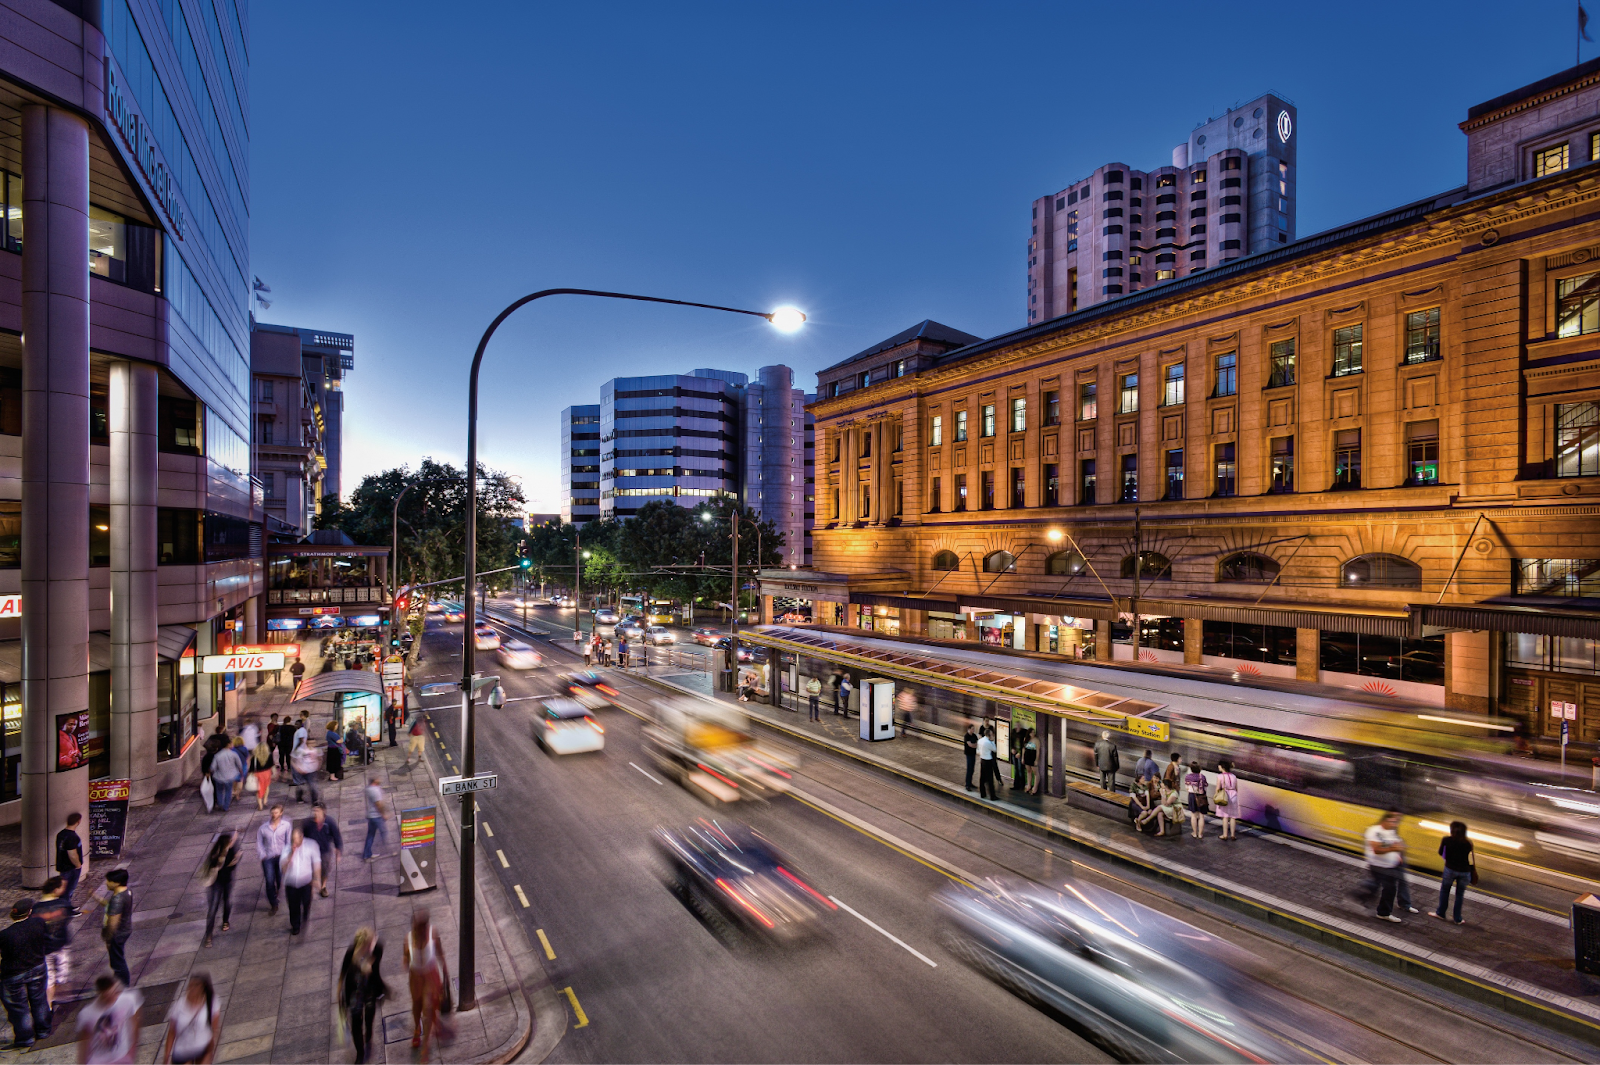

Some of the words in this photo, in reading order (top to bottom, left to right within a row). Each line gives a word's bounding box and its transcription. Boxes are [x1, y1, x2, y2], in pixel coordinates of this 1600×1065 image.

[105, 57, 138, 155] Roma
[138, 115, 168, 210] Mitchell
[167, 177, 186, 240] House
[225, 657, 265, 670] AVIS
[1141, 730, 1161, 739] Station
[455, 780, 478, 792] BANK
[483, 778, 494, 788] ST
